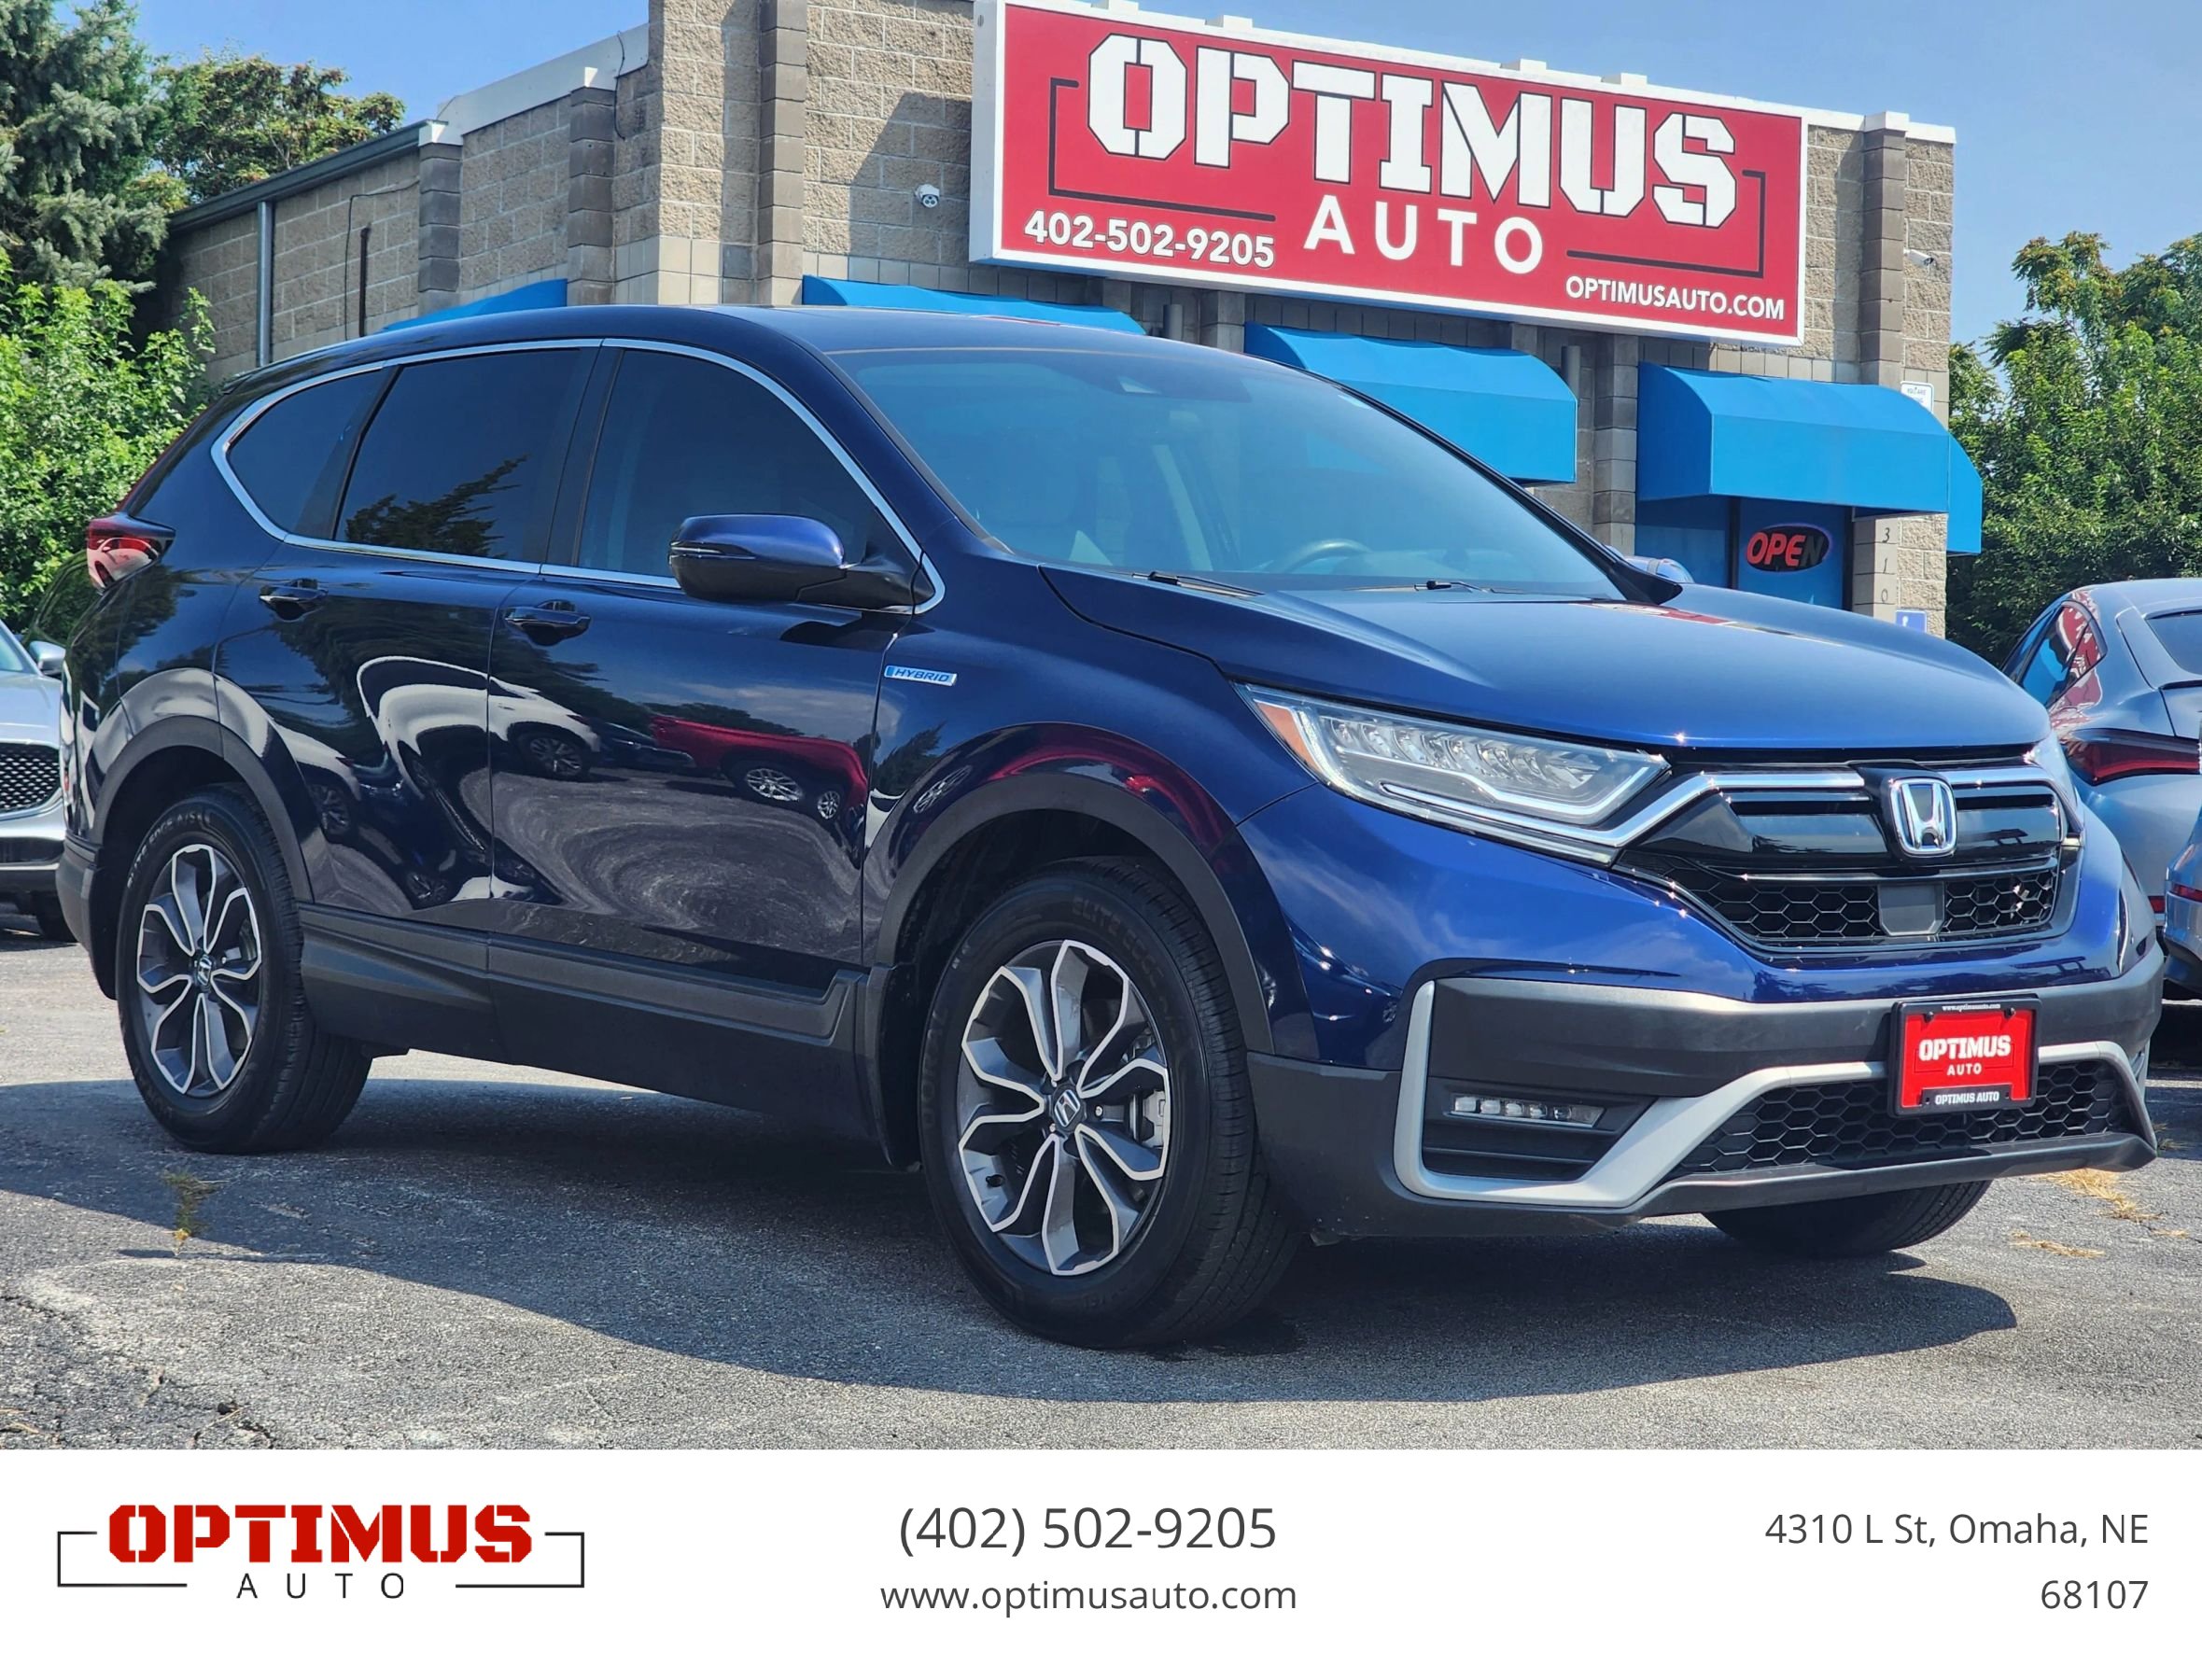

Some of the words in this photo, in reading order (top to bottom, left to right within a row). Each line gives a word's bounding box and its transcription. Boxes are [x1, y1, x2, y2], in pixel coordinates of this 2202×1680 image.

[1088, 34, 1737, 230] OPTIMUS
[1024, 210, 1276, 269] 402-502-9205
[1304, 194, 1543, 274] AUTO
[1565, 275, 1785, 320] OPTIMUSAUTO.COM
[1746, 531, 1824, 567] OPEN
[893, 667, 950, 682] HYBRID
[1918, 1034, 2012, 1062] OPTIMUS
[1946, 1062, 1983, 1076] AUTO
[1934, 1093, 1975, 1105] OPTIMUS
[1976, 1091, 2000, 1103] AUTO
